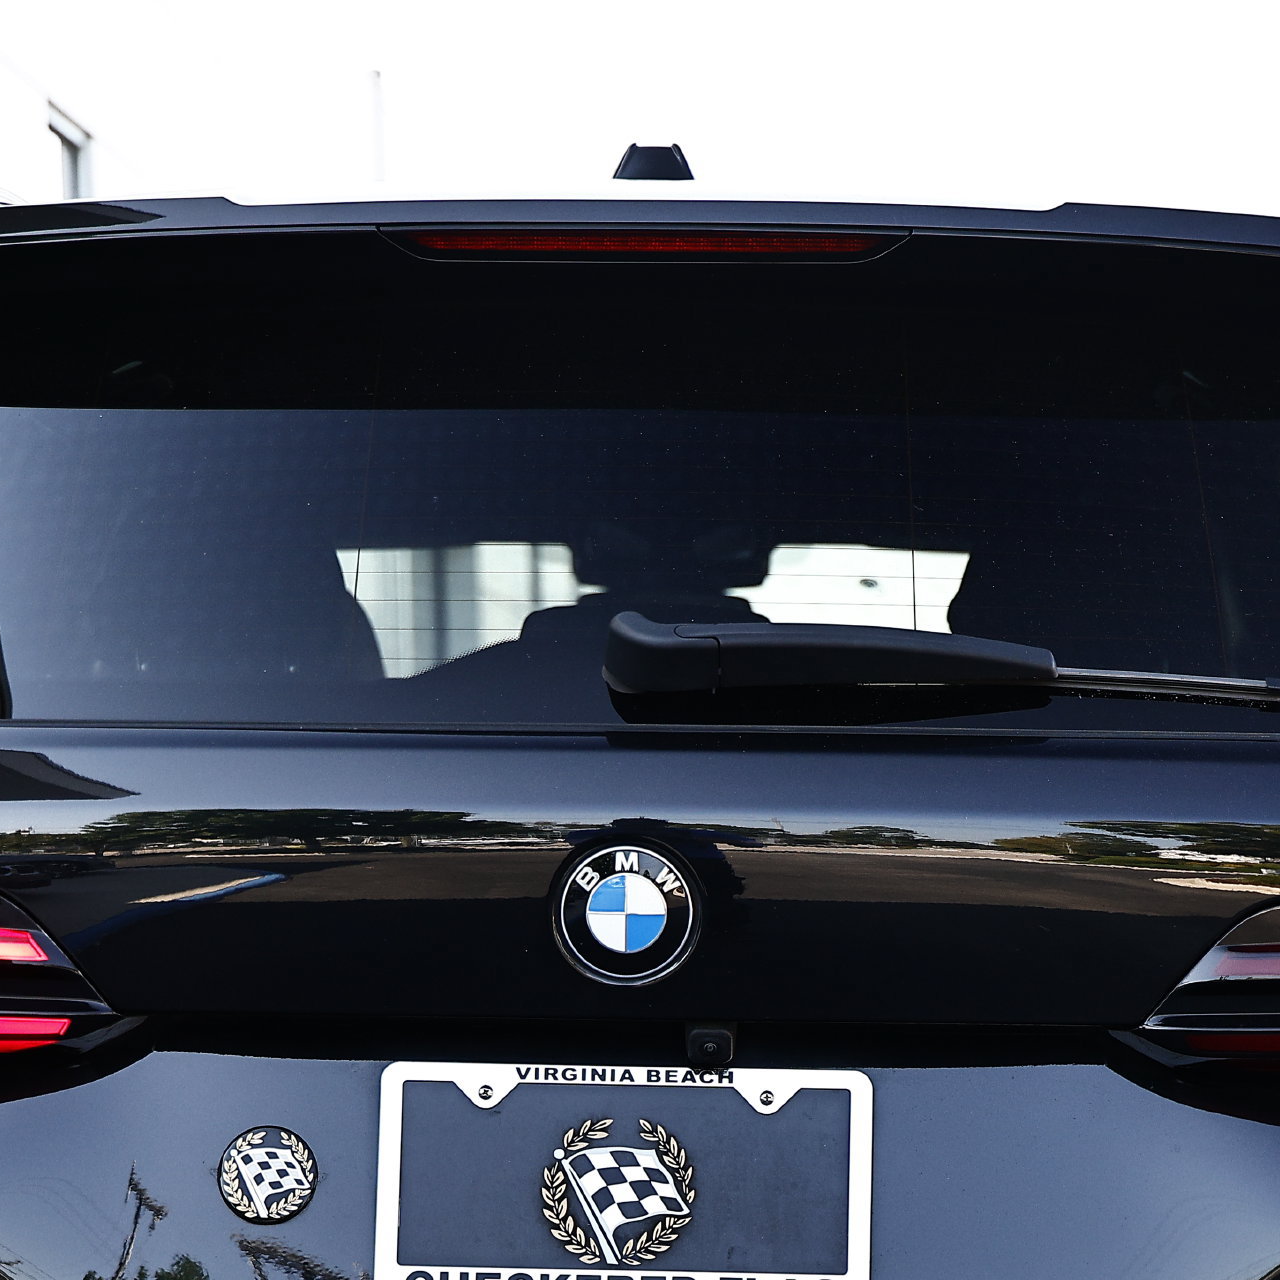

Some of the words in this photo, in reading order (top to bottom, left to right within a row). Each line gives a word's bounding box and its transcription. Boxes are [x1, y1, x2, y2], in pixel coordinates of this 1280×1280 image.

[575, 851, 686, 898] BMW
[516, 1067, 635, 1083] VIRGINIA
[646, 1069, 734, 1084] BEACH
